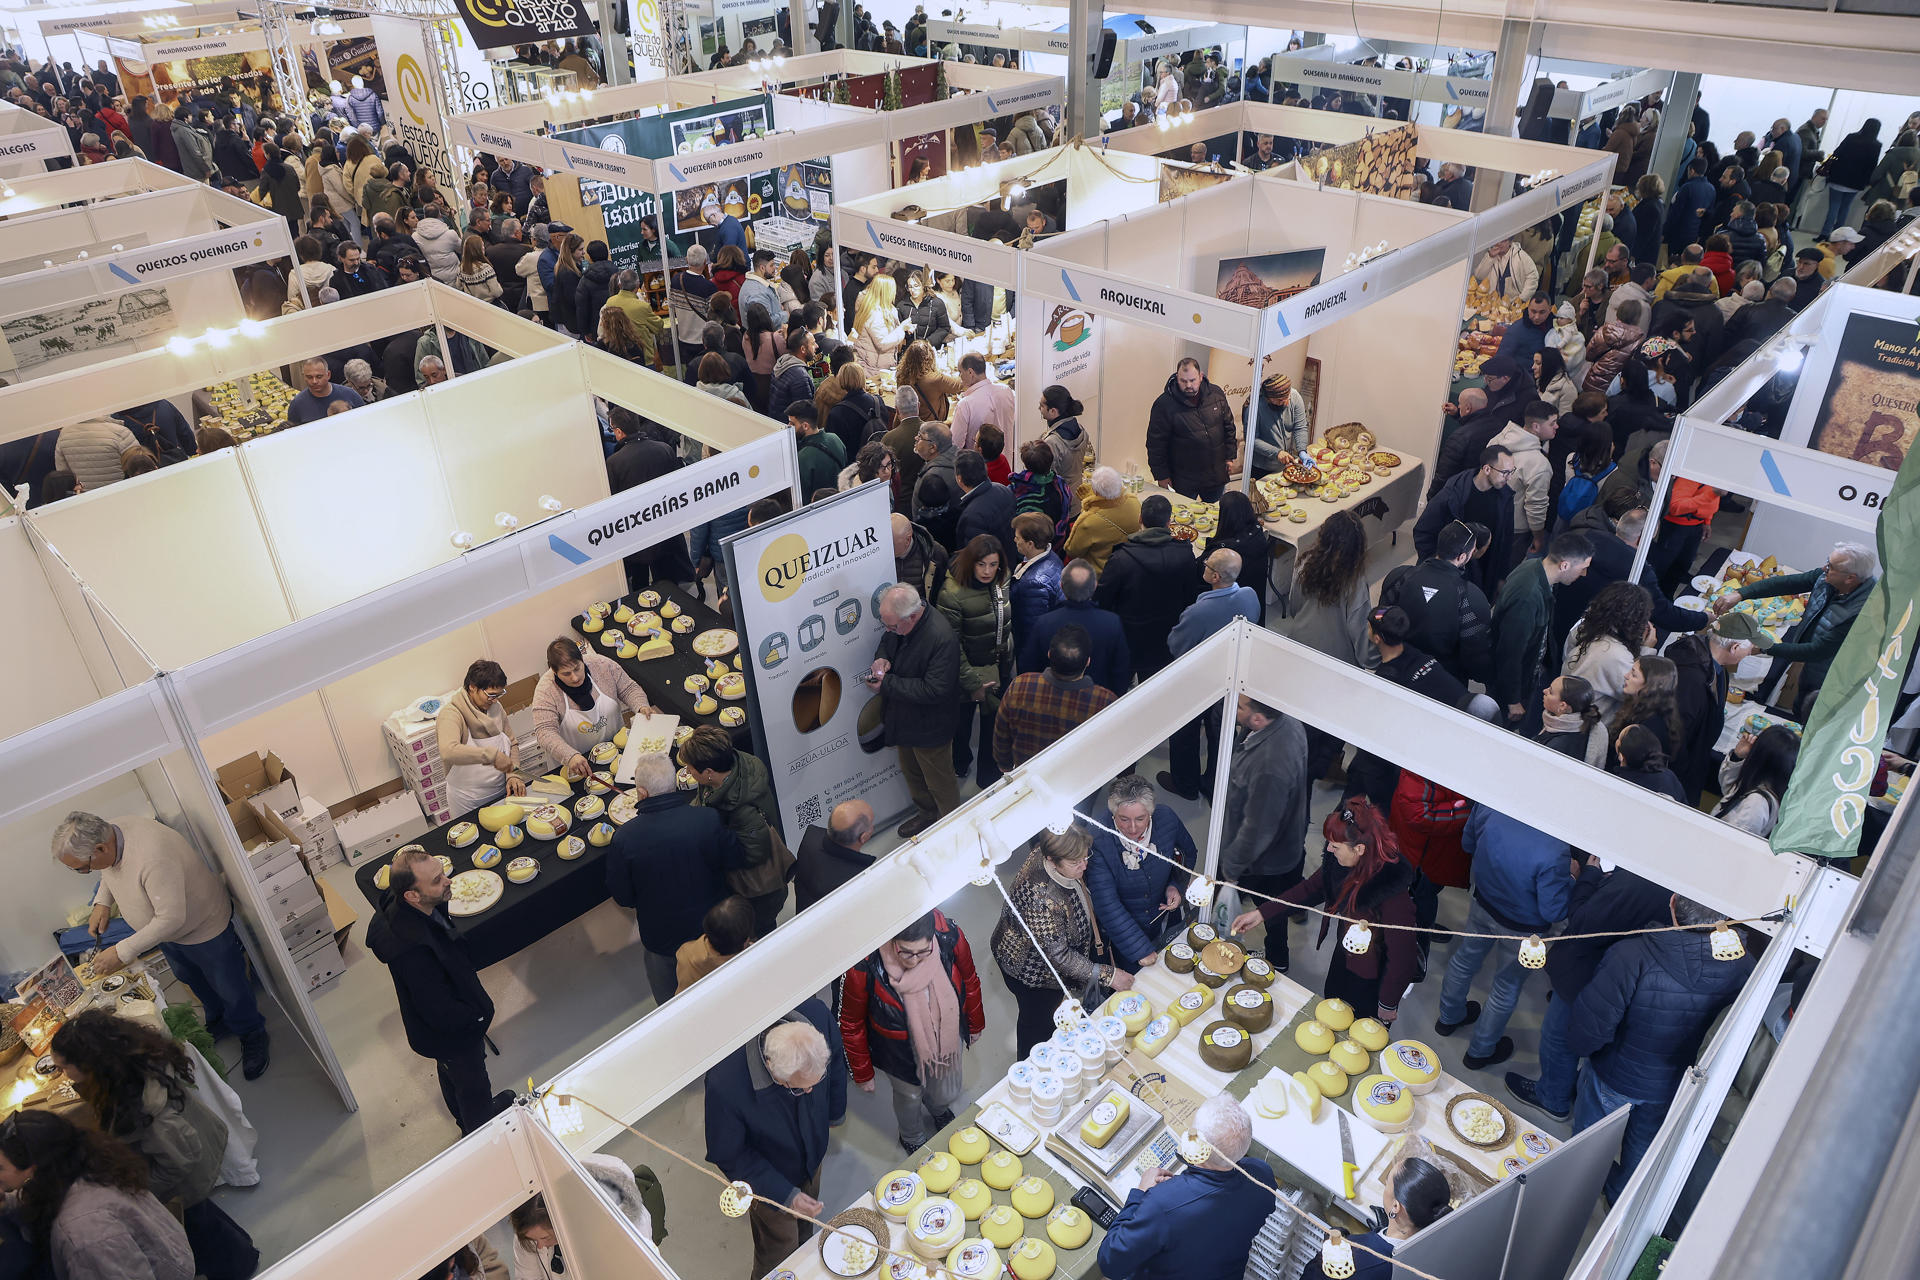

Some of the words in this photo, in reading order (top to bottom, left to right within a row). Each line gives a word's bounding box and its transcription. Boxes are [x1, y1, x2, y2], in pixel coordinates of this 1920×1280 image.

[504, 3, 577, 27] QUEIXO
[155, 80, 197, 91] Presentes
[198, 78, 209, 86] en
[228, 70, 264, 81] ercados
[1458, 88, 1489, 97] QUEIXERÍ
[400, 116, 425, 143] festa
[425, 123, 439, 147] do
[480, 132, 512, 149] GALMESÁN
[594, 160, 604, 168] DON
[604, 163, 626, 174] CRISANTO
[682, 160, 717, 175] QUEIXERÍA
[718, 158, 733, 168] DON
[733, 151, 763, 165] CRISANTO
[136, 253, 187, 275] QUEIXOS
[189, 240, 249, 261] QUEINAGA
[880, 233, 906, 246] QUESOS
[907, 240, 947, 257] ARTESANOS
[948, 250, 972, 263] AUTOR
[1100, 288, 1166, 315] ARQUEIXAL
[1304, 290, 1347, 319] ARQUEIXAL
[1874, 338, 1908, 354] Manos
[1908, 345, 1920, 357] Ar
[1052, 359, 1071, 371] Formas
[1072, 355, 1079, 363] de
[1080, 351, 1091, 360] vida
[1877, 352, 1916, 367] Tradición
[1055, 363, 1088, 381] sustentables
[1223, 384, 1252, 396] Ecoagr
[1838, 484, 1858, 501] O
[587, 492, 689, 546] QUEIXERÍAS
[692, 471, 741, 502] BAMA
[765, 526, 879, 589] QUEIZUAR
[801, 566, 835, 584] tradición
[815, 592, 837, 604] VALORES
[803, 651, 827, 664] Innovación
[768, 669, 789, 681] Tradición
[789, 737, 849, 772] ARZÚA-ULLOA
